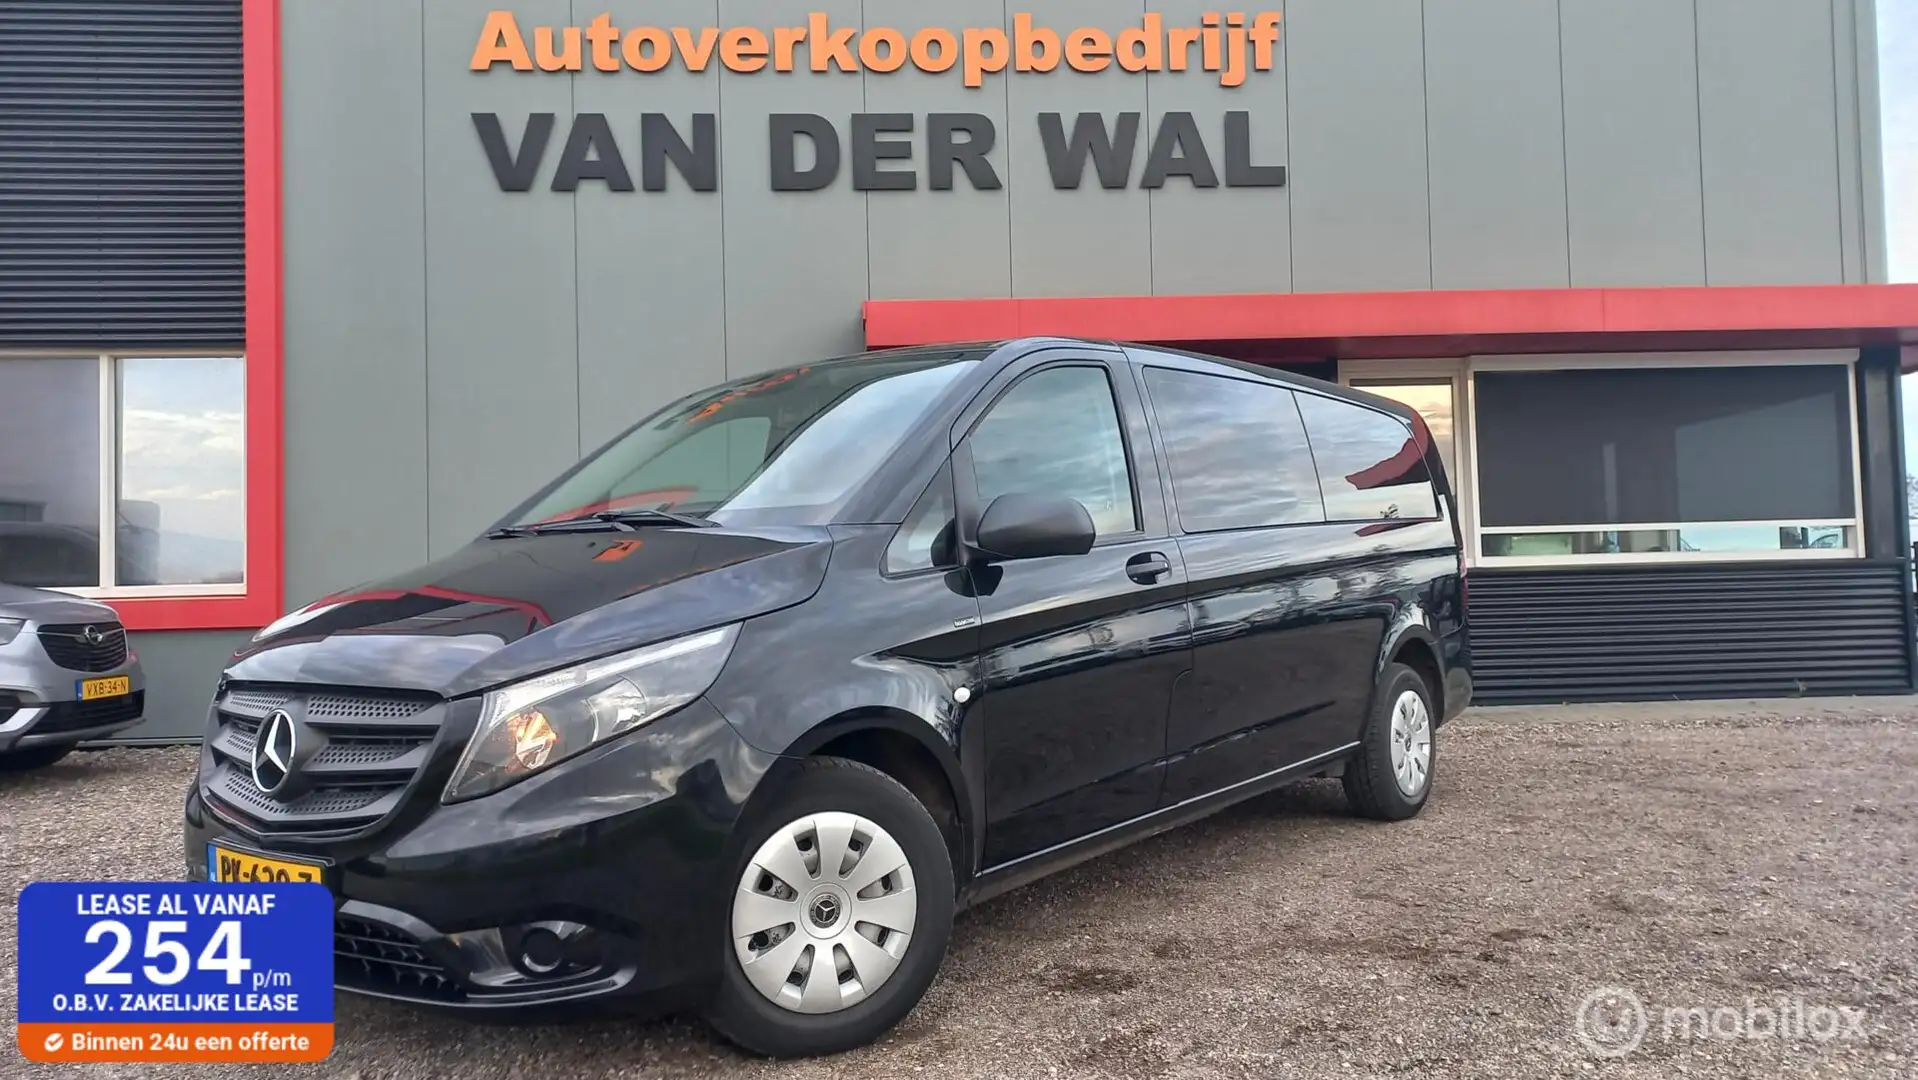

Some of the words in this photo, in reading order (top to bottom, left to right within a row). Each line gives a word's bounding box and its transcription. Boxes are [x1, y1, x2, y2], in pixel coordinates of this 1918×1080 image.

[471, 11, 1281, 88] Autoverkoopbedrijf
[472, 113, 718, 192] VAN
[770, 113, 1002, 192] DER
[1038, 111, 1286, 190] WAL
